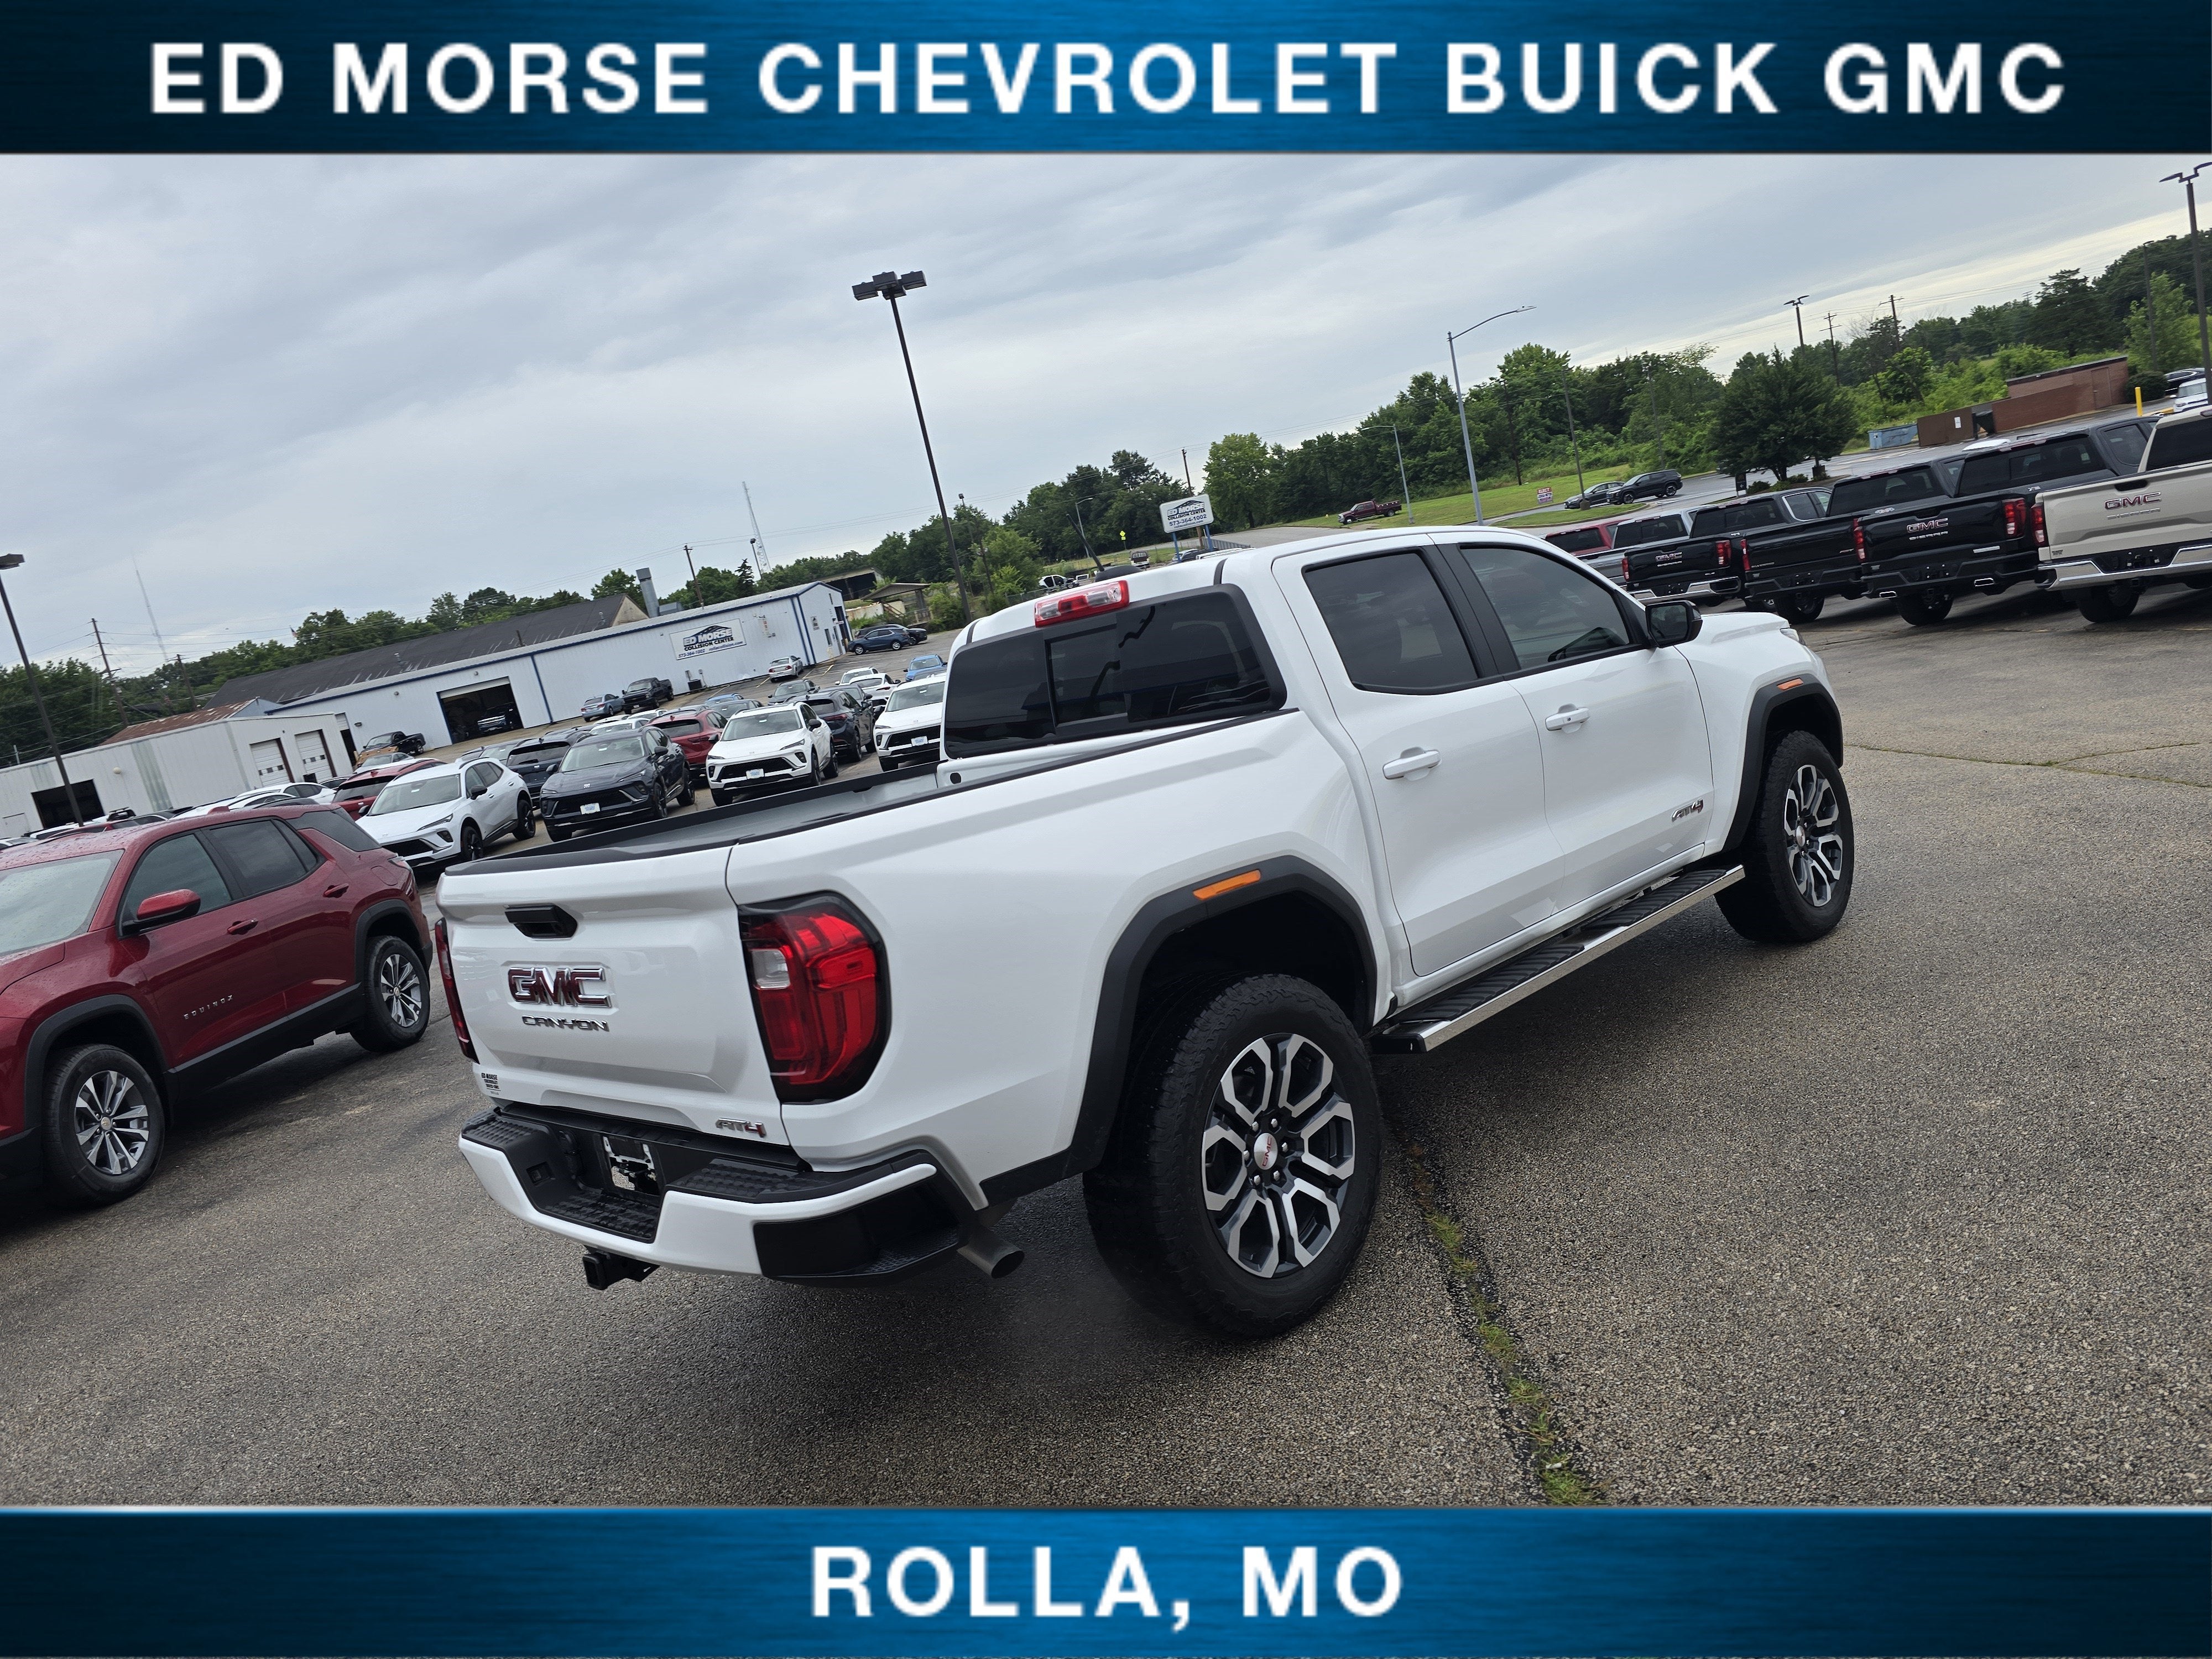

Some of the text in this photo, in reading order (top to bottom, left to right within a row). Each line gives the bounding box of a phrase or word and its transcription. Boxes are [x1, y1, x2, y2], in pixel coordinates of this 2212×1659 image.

[2105, 492, 2162, 510] GMC
[1169, 514, 1207, 526] 573-364-1002
[1906, 518, 1948, 533] GMC
[1655, 552, 1682, 561] GMC
[684, 628, 732, 646] ED MORSE
[684, 637, 734, 651] COLLISION CENTER
[1671, 797, 1703, 822] AT4
[508, 967, 612, 1009] GMC
[184, 994, 233, 1020] EQUINOX
[521, 1015, 610, 1032] CANYON
[715, 1118, 767, 1138] AT4
[1262, 1136, 1272, 1167] GMC
